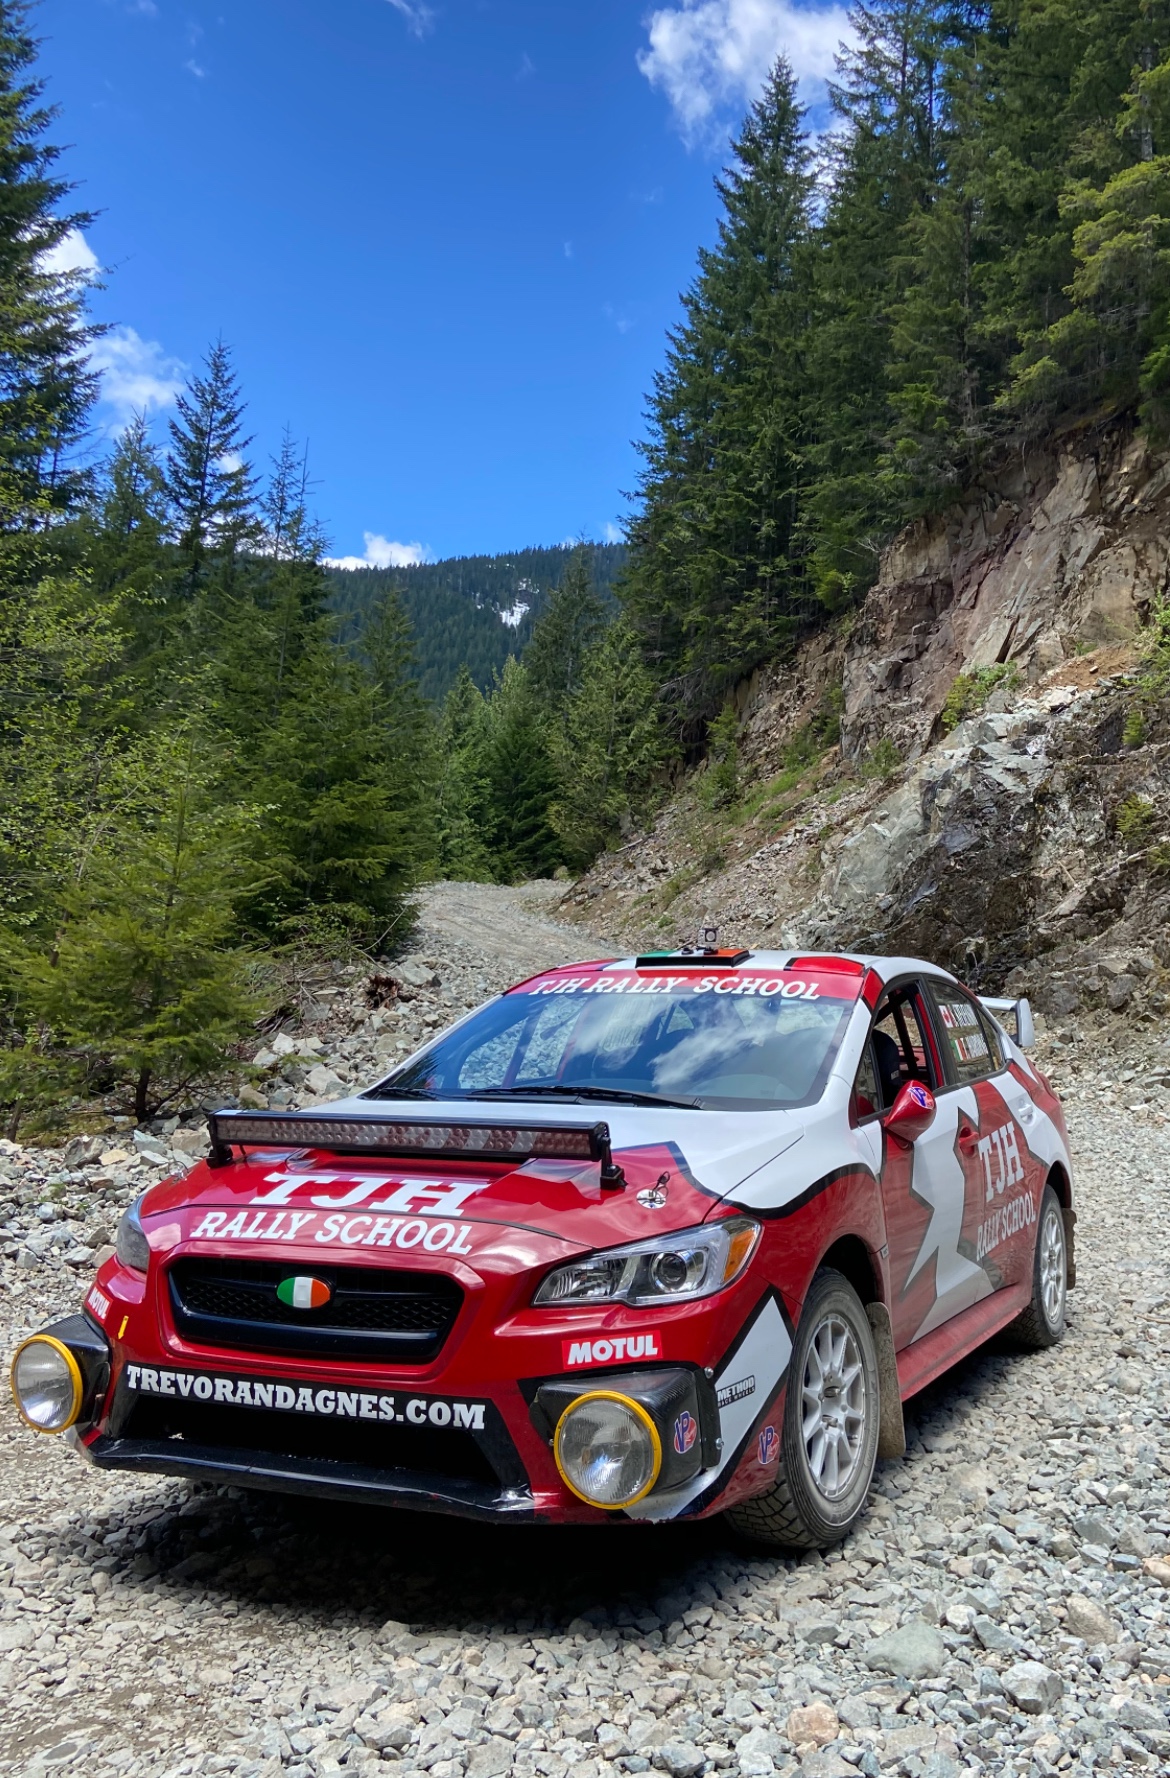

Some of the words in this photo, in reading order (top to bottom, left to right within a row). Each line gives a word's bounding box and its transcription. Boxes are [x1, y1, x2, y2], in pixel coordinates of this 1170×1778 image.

[529, 980, 586, 996] TJH
[585, 977, 687, 994] RALLY
[693, 977, 821, 1001] SCHOOL
[978, 1121, 1025, 1202] TJH
[249, 1172, 491, 1217] TJH
[190, 1211, 317, 1240] RALLY
[315, 1213, 474, 1255] SCHOOL
[976, 1210, 1002, 1262] RALLY
[1001, 1190, 1036, 1241] SCHOOL
[88, 1286, 110, 1320] MOTUL
[567, 1334, 659, 1366] MOTUL
[127, 1365, 486, 1430] TREVORANDAGNES.COM
[717, 1376, 754, 1401] METHOD
[674, 1410, 692, 1454] VP
[758, 1425, 775, 1464] VP
